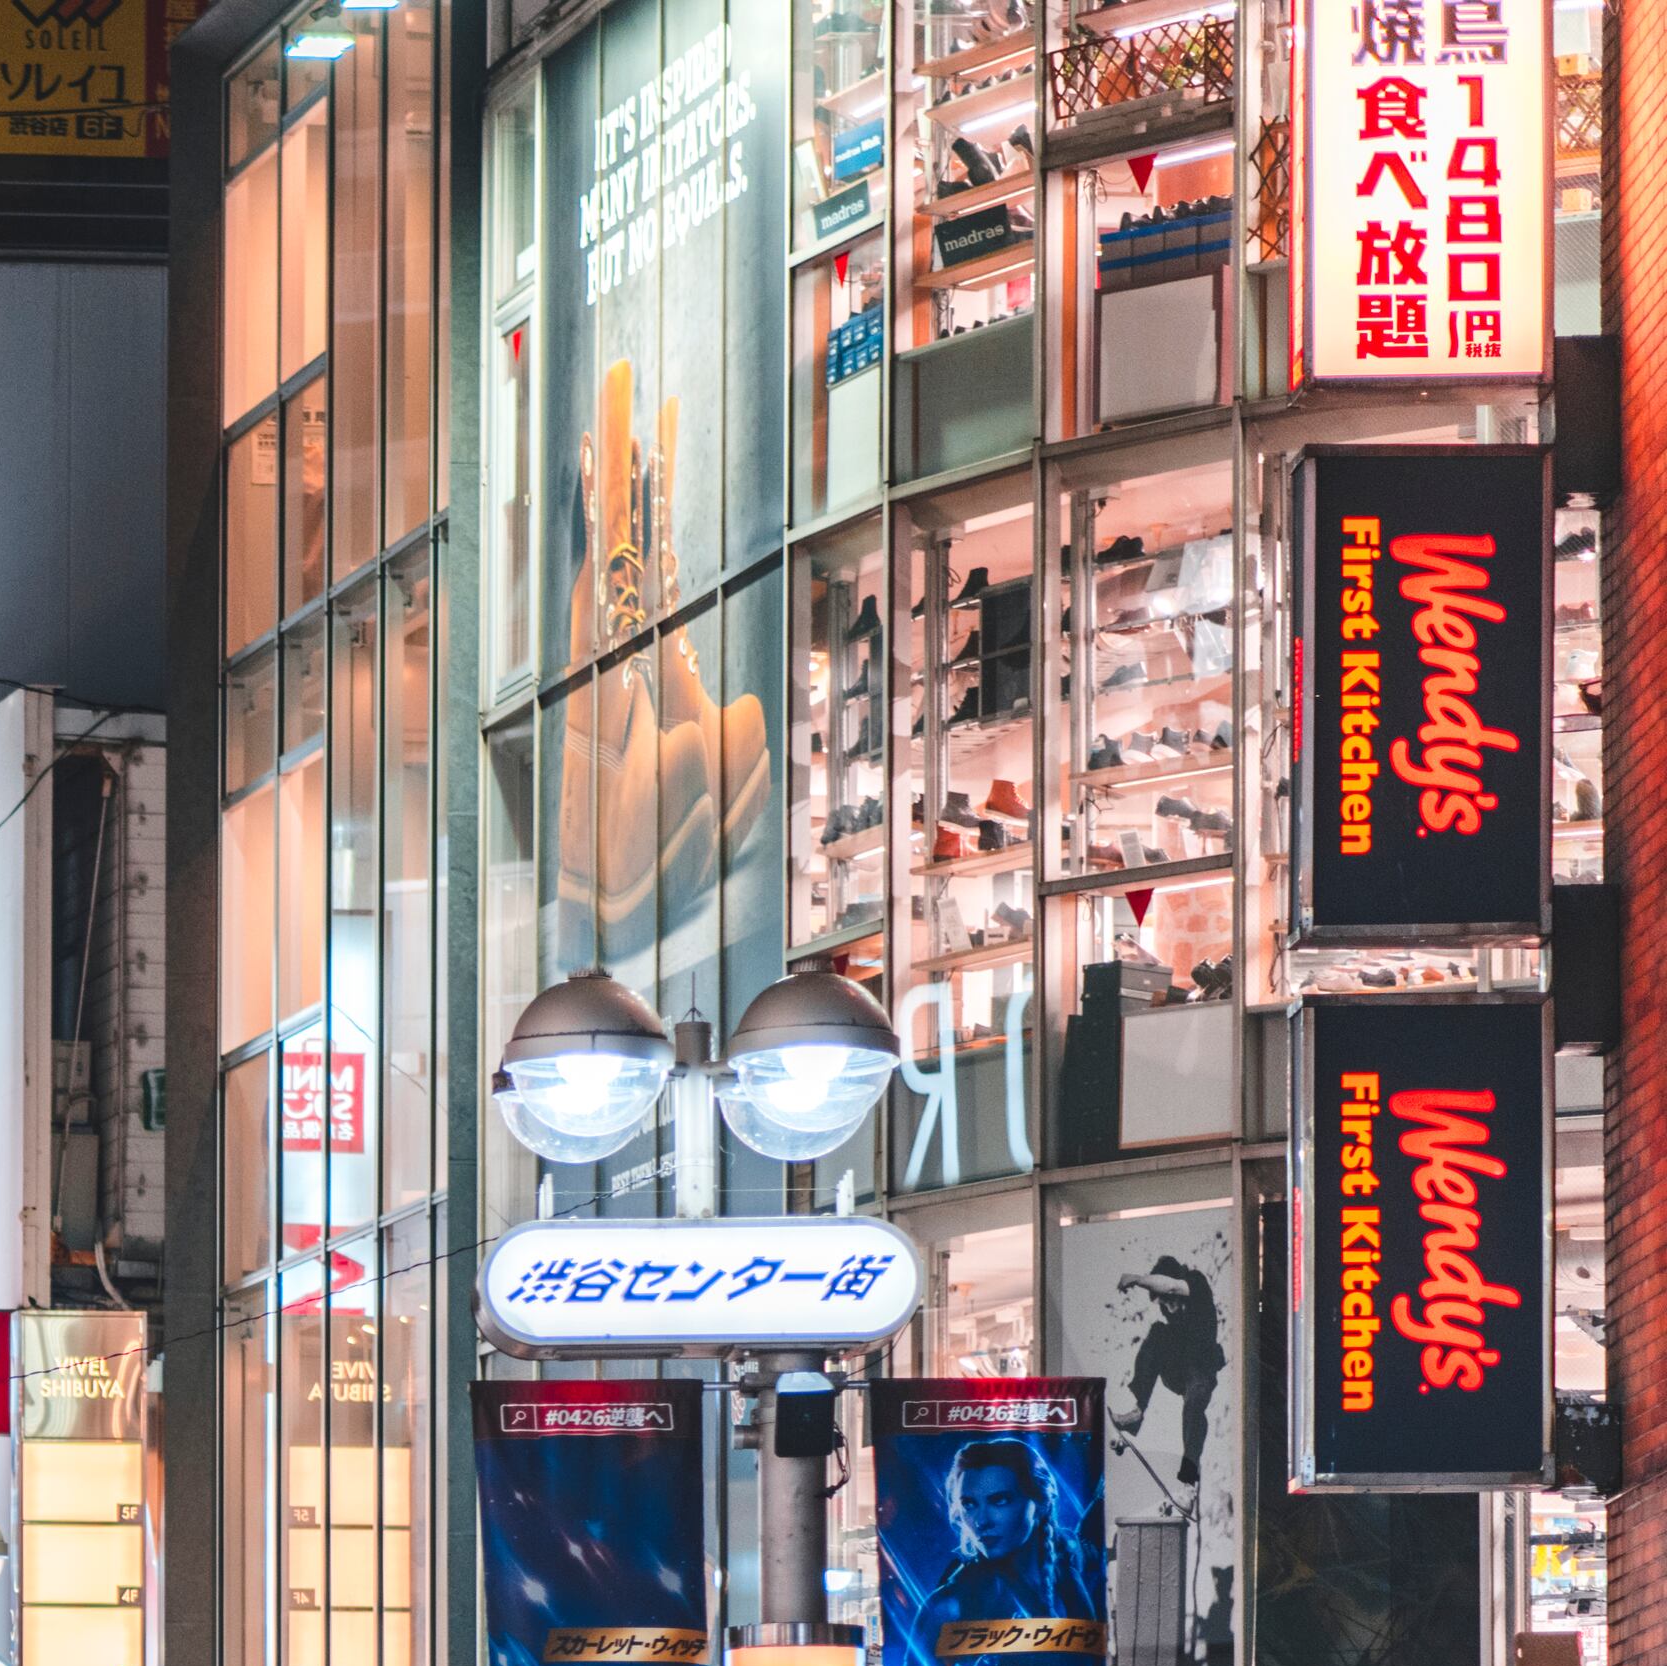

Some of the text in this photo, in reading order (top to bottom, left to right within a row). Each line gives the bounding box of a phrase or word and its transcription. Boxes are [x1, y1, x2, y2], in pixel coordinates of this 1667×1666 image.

[24, 28, 108, 51] SOLEIL
[594, 22, 732, 172] IT'S INSPIRED
[80, 118, 118, 138] 6F
[580, 156, 638, 249] MANY
[820, 199, 865, 230] madras
[1355, 76, 1429, 360] 食べ放題
[944, 222, 1005, 252] madras
[587, 230, 625, 305] BUT
[628, 207, 657, 276] NO
[1340, 515, 1381, 856] First Kitchen
[1389, 533, 1520, 836] Wendy's
[1341, 1072, 1381, 1413] First Kitchen
[1389, 1087, 1522, 1394] Wendy's
[506, 1254, 896, 1304] 渋谷センター街
[54, 1356, 110, 1378] VIVEL
[39, 1377, 126, 1401] SHIBUYA
[544, 1404, 665, 1428] #0426逆襲へ
[947, 1403, 1068, 1427] #0426逆襲へ
[119, 1505, 140, 1522] 5F
[119, 1588, 140, 1603] 4F
